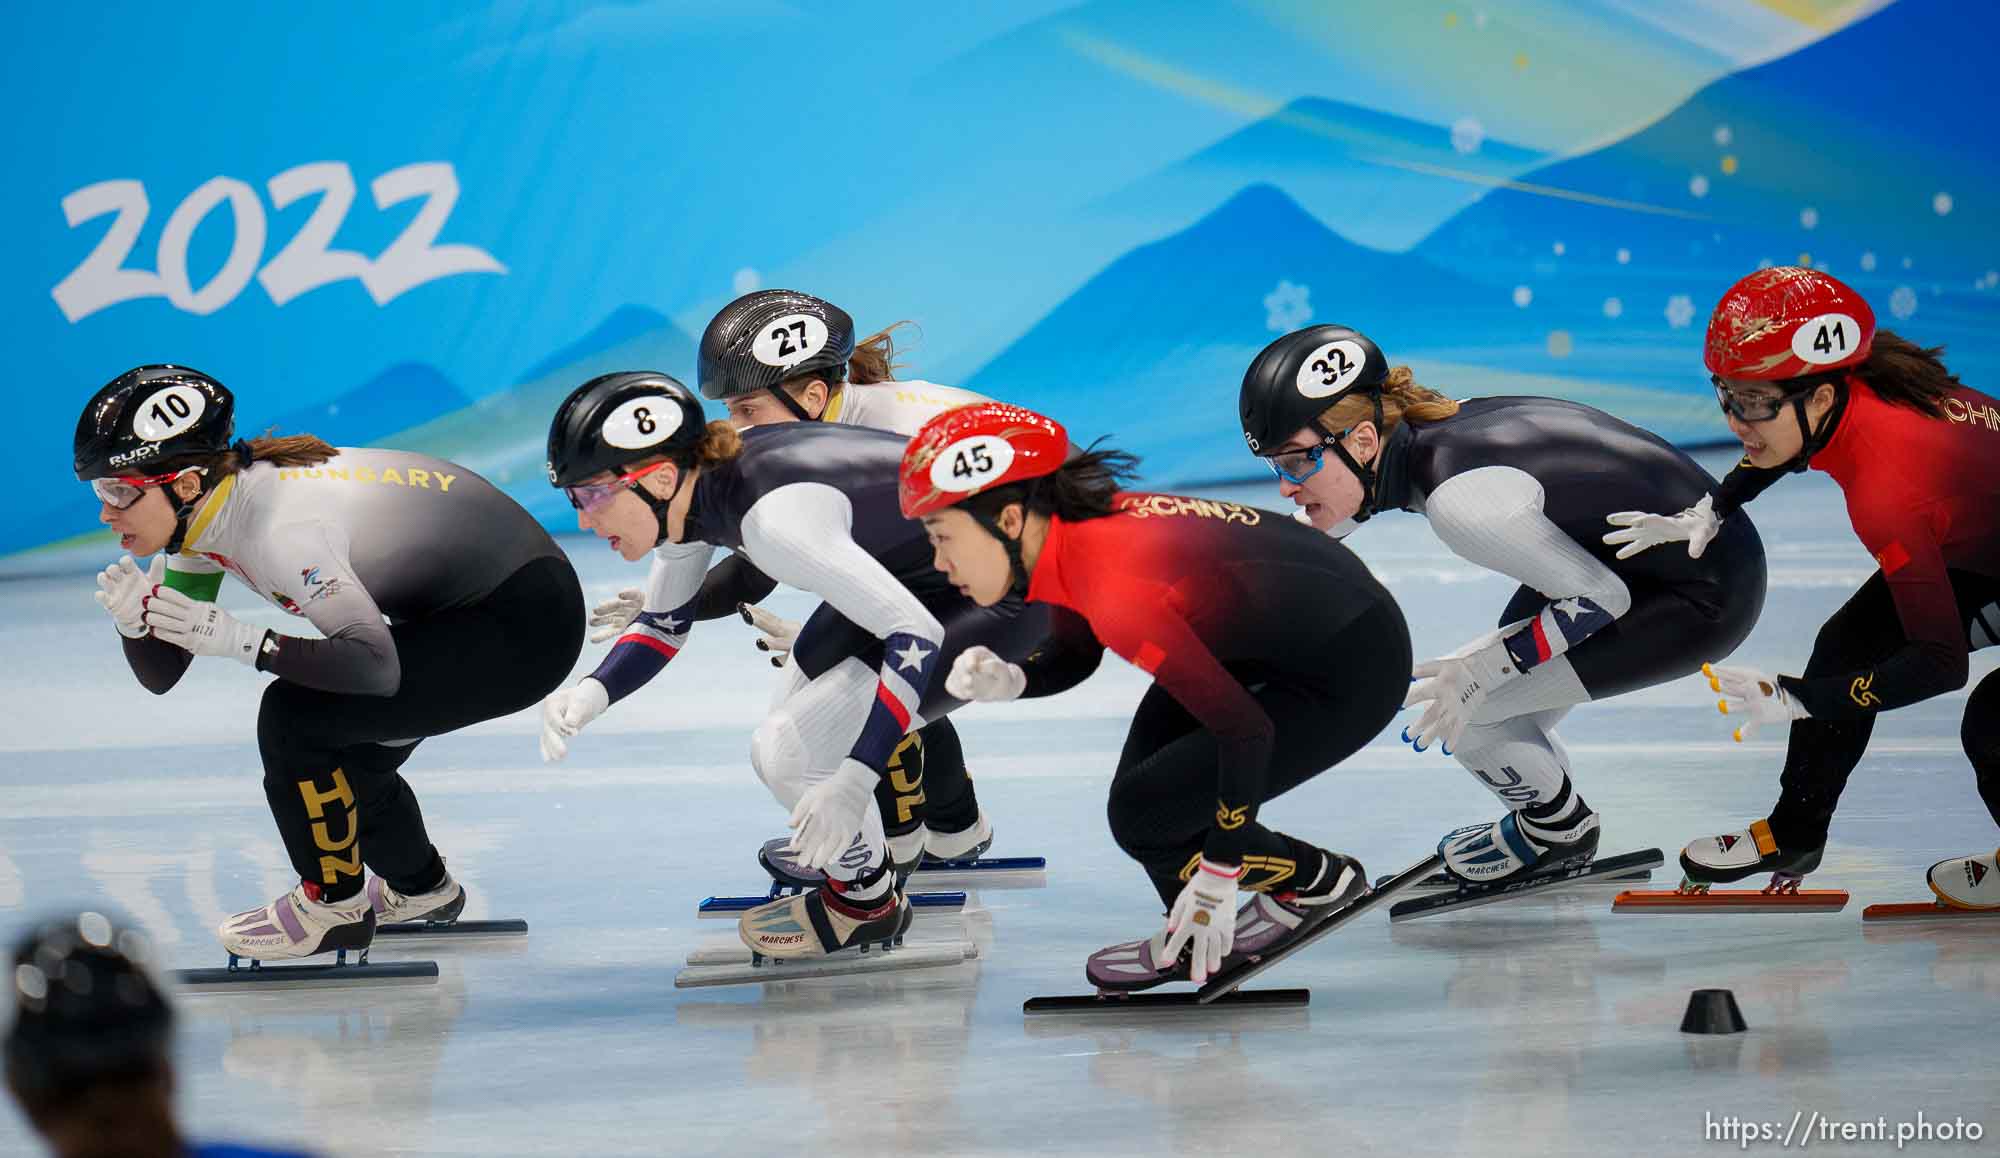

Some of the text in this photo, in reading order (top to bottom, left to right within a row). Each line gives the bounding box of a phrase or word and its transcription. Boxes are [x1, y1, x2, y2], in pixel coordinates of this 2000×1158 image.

[50, 160, 508, 324] 2022
[771, 320, 808, 358] 27
[1813, 321, 1846, 354] 41
[1311, 348, 1355, 386] 32
[151, 394, 191, 428] 10
[633, 407, 656, 435] 8
[109, 441, 162, 465] RUDY
[952, 444, 993, 480] 45
[1150, 495, 1226, 520] CHN
[298, 767, 363, 885] HUN
[1466, 859, 1511, 875] MARCHESE
[759, 934, 805, 944] MARCHESE
